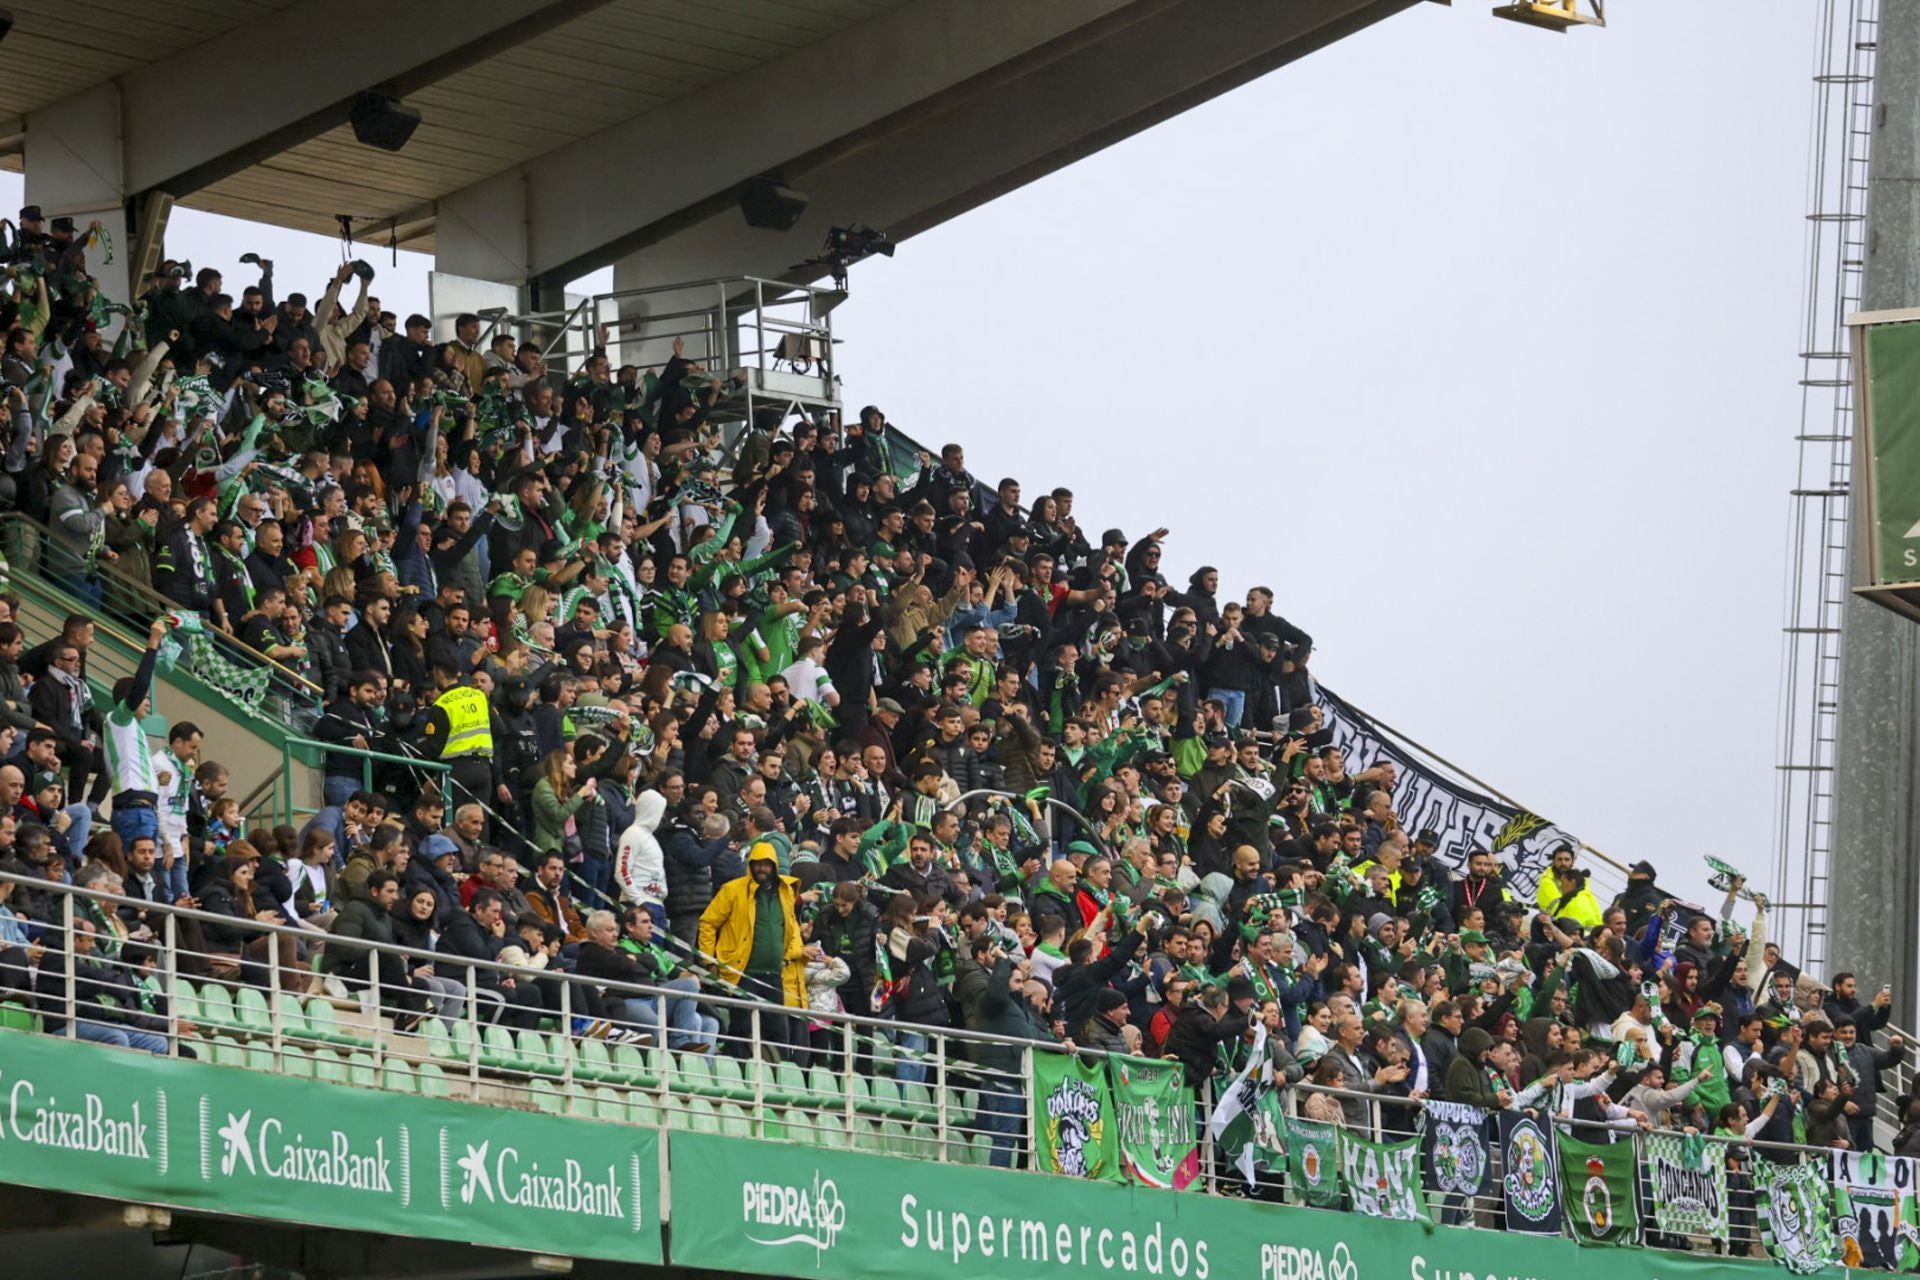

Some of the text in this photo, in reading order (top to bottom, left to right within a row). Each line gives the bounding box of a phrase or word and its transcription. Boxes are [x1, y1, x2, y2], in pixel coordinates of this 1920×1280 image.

[9, 1079, 150, 1159] CaixaBank
[258, 1118, 393, 1193] CaixaBank
[496, 1147, 625, 1218] CaixaBank
[901, 1193, 1209, 1280] Supermercados
